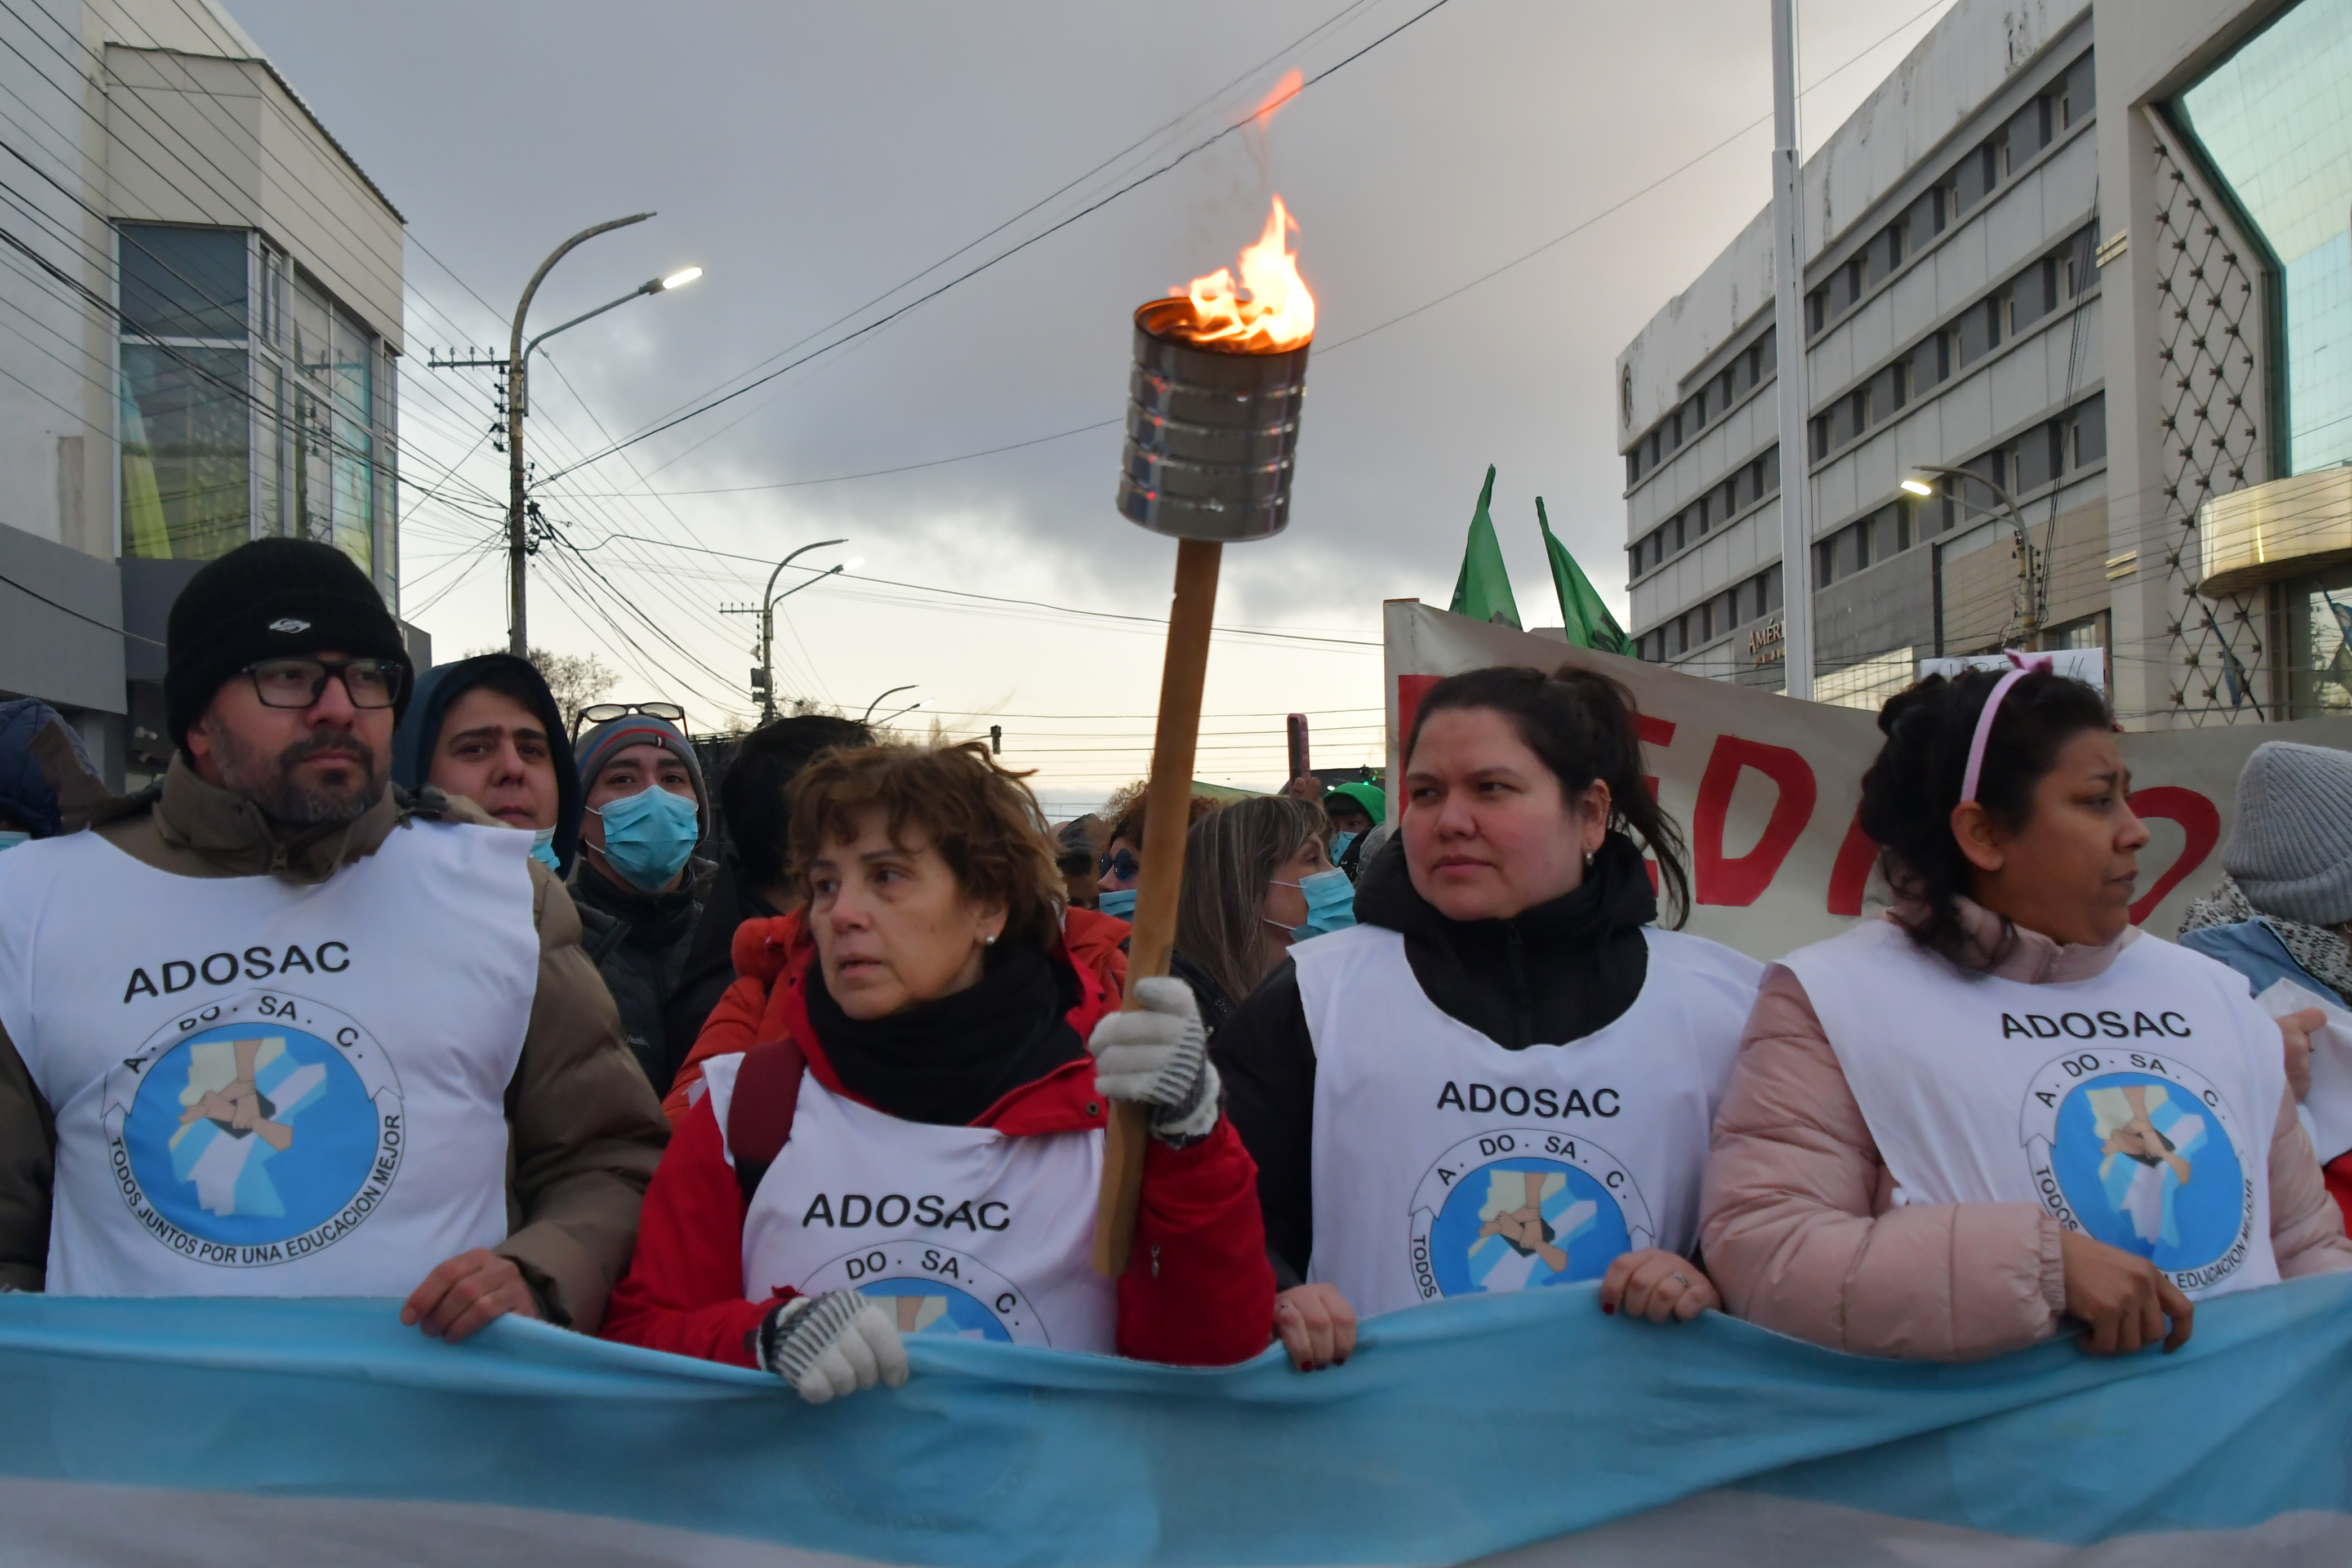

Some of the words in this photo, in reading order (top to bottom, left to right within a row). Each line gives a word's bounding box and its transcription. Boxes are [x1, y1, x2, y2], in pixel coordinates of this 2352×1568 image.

[123, 942, 350, 1004] ADOSAC
[2002, 1011, 2191, 1039] ADOSAC
[1437, 1081, 1620, 1119] ADOSAC
[112, 1137, 141, 1206] TODOS
[139, 1208, 197, 1254] JUNTOS
[199, 1244, 237, 1263] POR
[243, 1246, 283, 1263] UNA
[286, 1186, 381, 1257] EDUCACION
[373, 1115, 400, 1186] MEJOR
[803, 1193, 1010, 1231] ADOSAC
[1413, 1235, 1436, 1297] TODOS
[2177, 1239, 2246, 1289] EDUCACION
